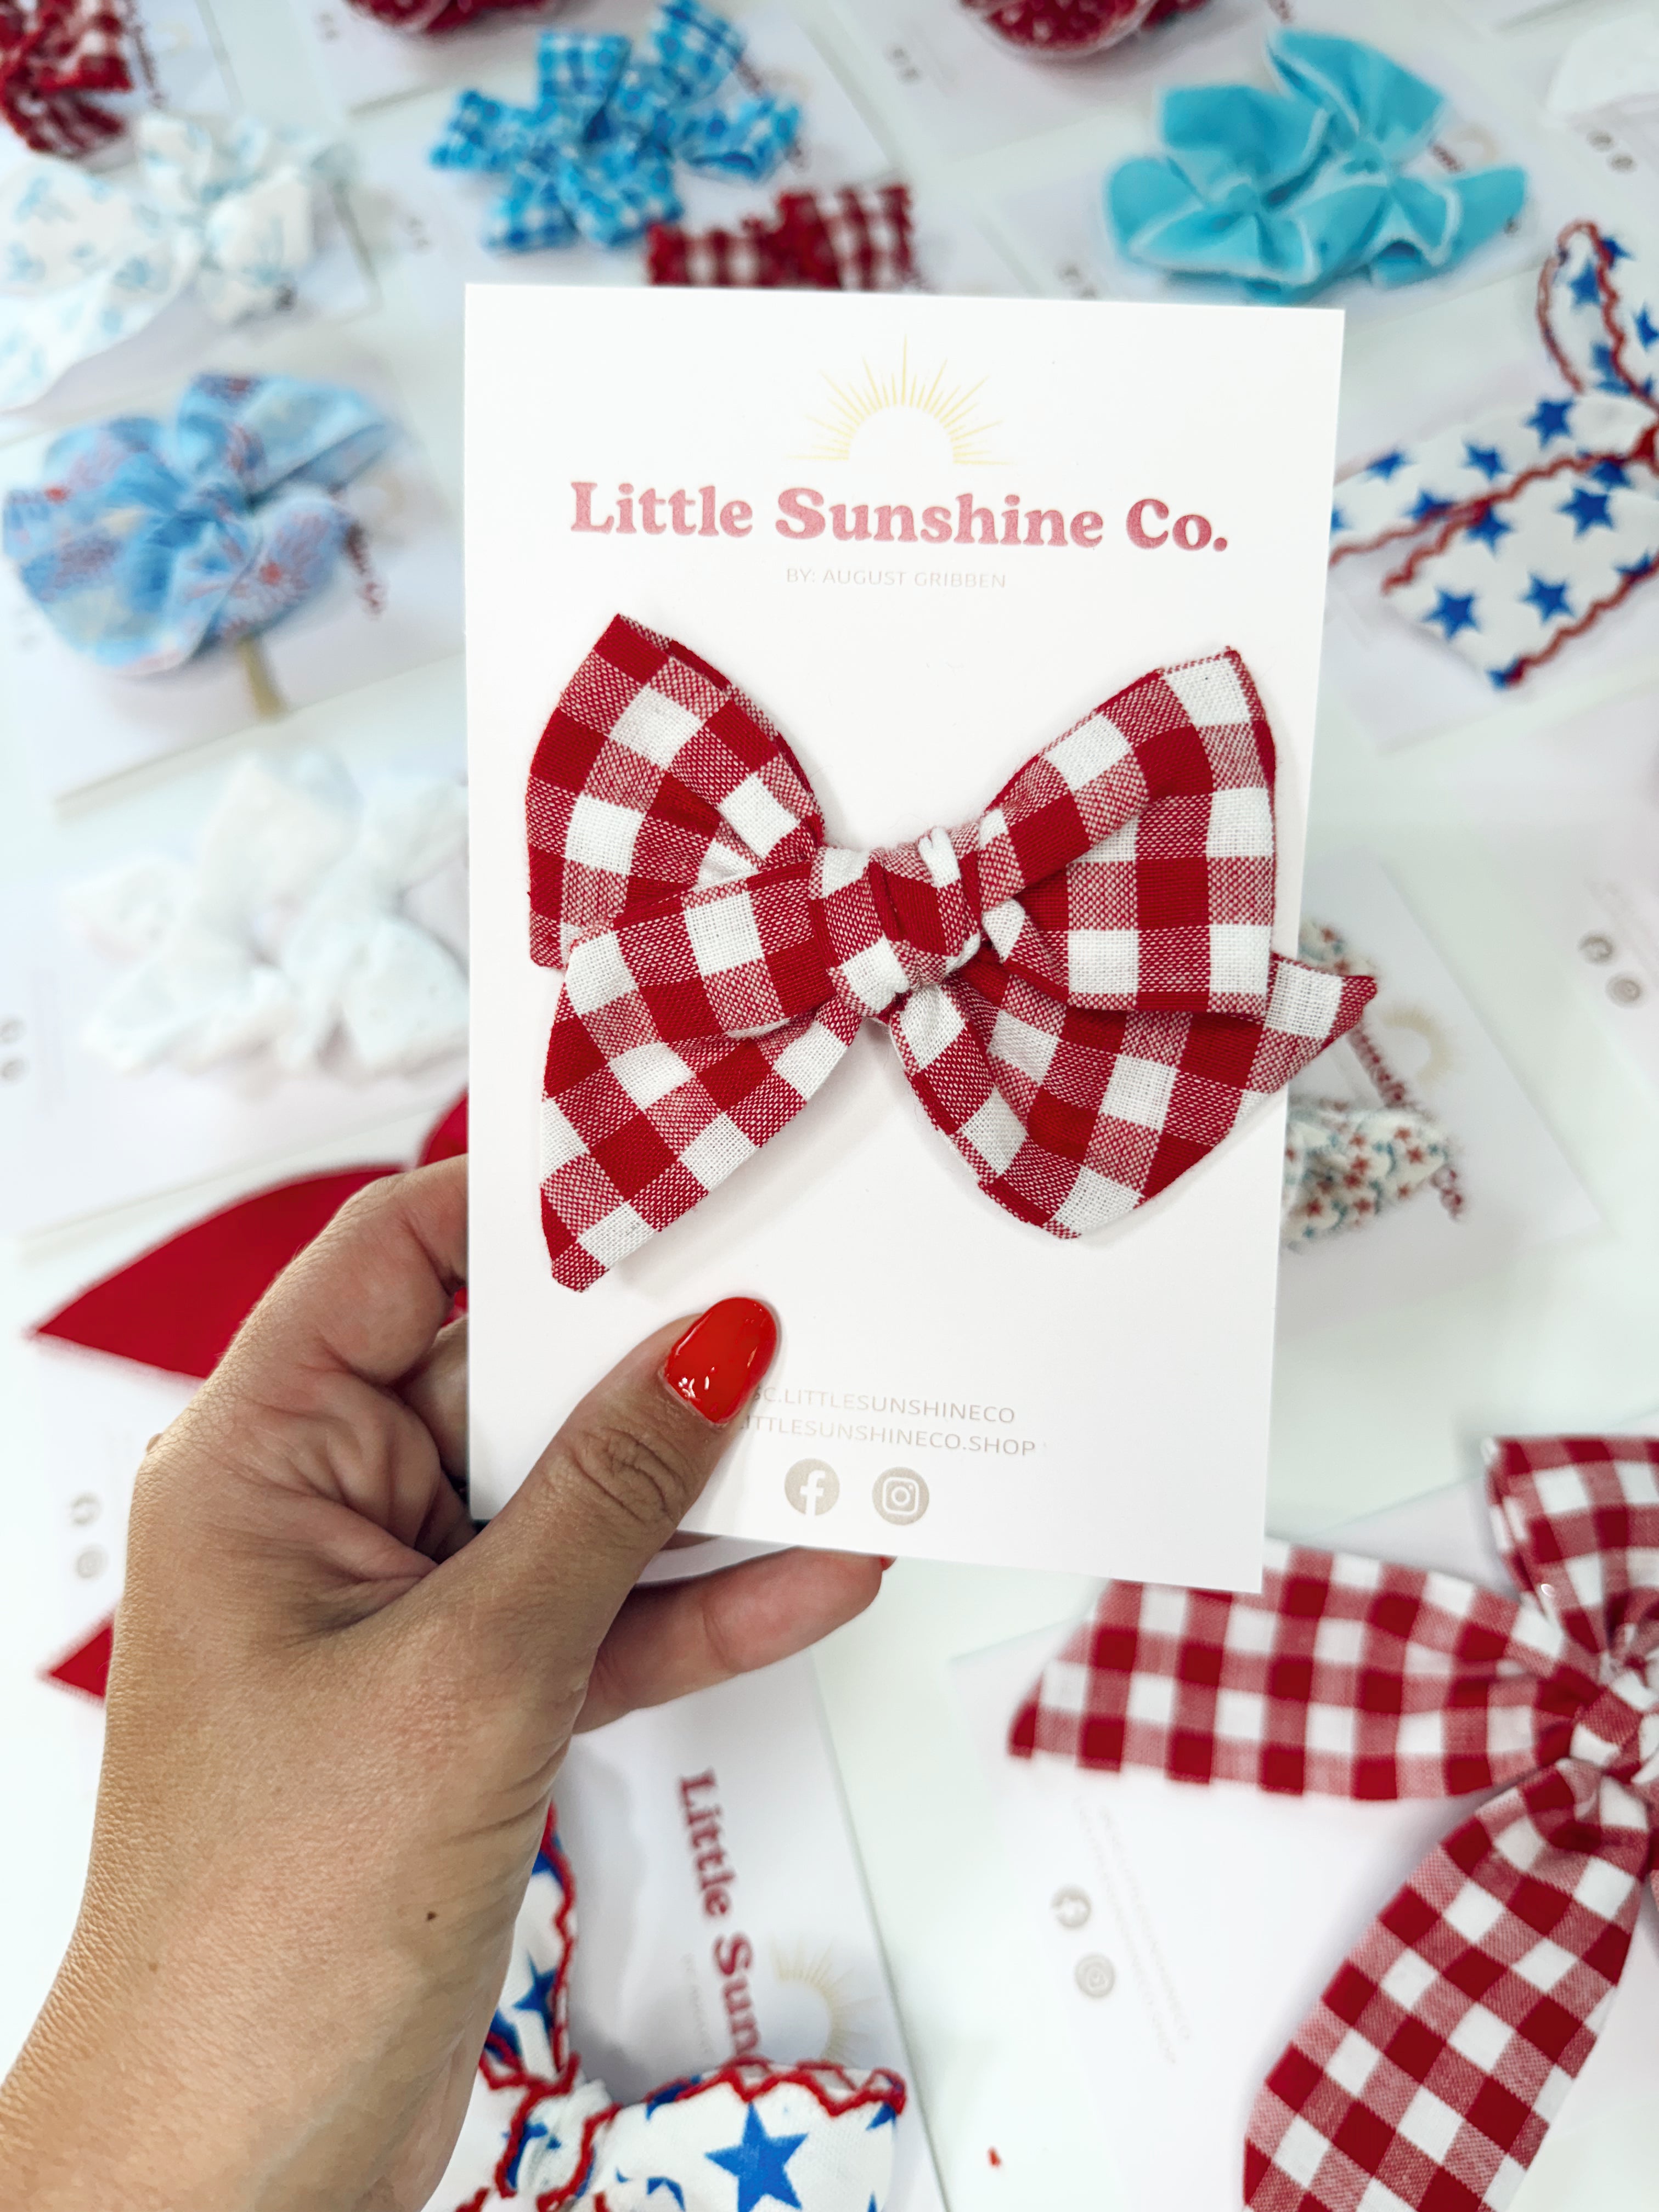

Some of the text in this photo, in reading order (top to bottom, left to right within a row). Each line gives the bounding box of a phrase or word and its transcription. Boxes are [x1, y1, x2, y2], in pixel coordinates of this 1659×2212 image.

[570, 481, 1229, 552] Little Sunshine Co.
[786, 567, 1006, 589] BY: AUGUST GRIBBEN
[740, 1414, 1037, 1457] ITTLESUNSHINECO.SHOP
[678, 1768, 735, 1918] Little
